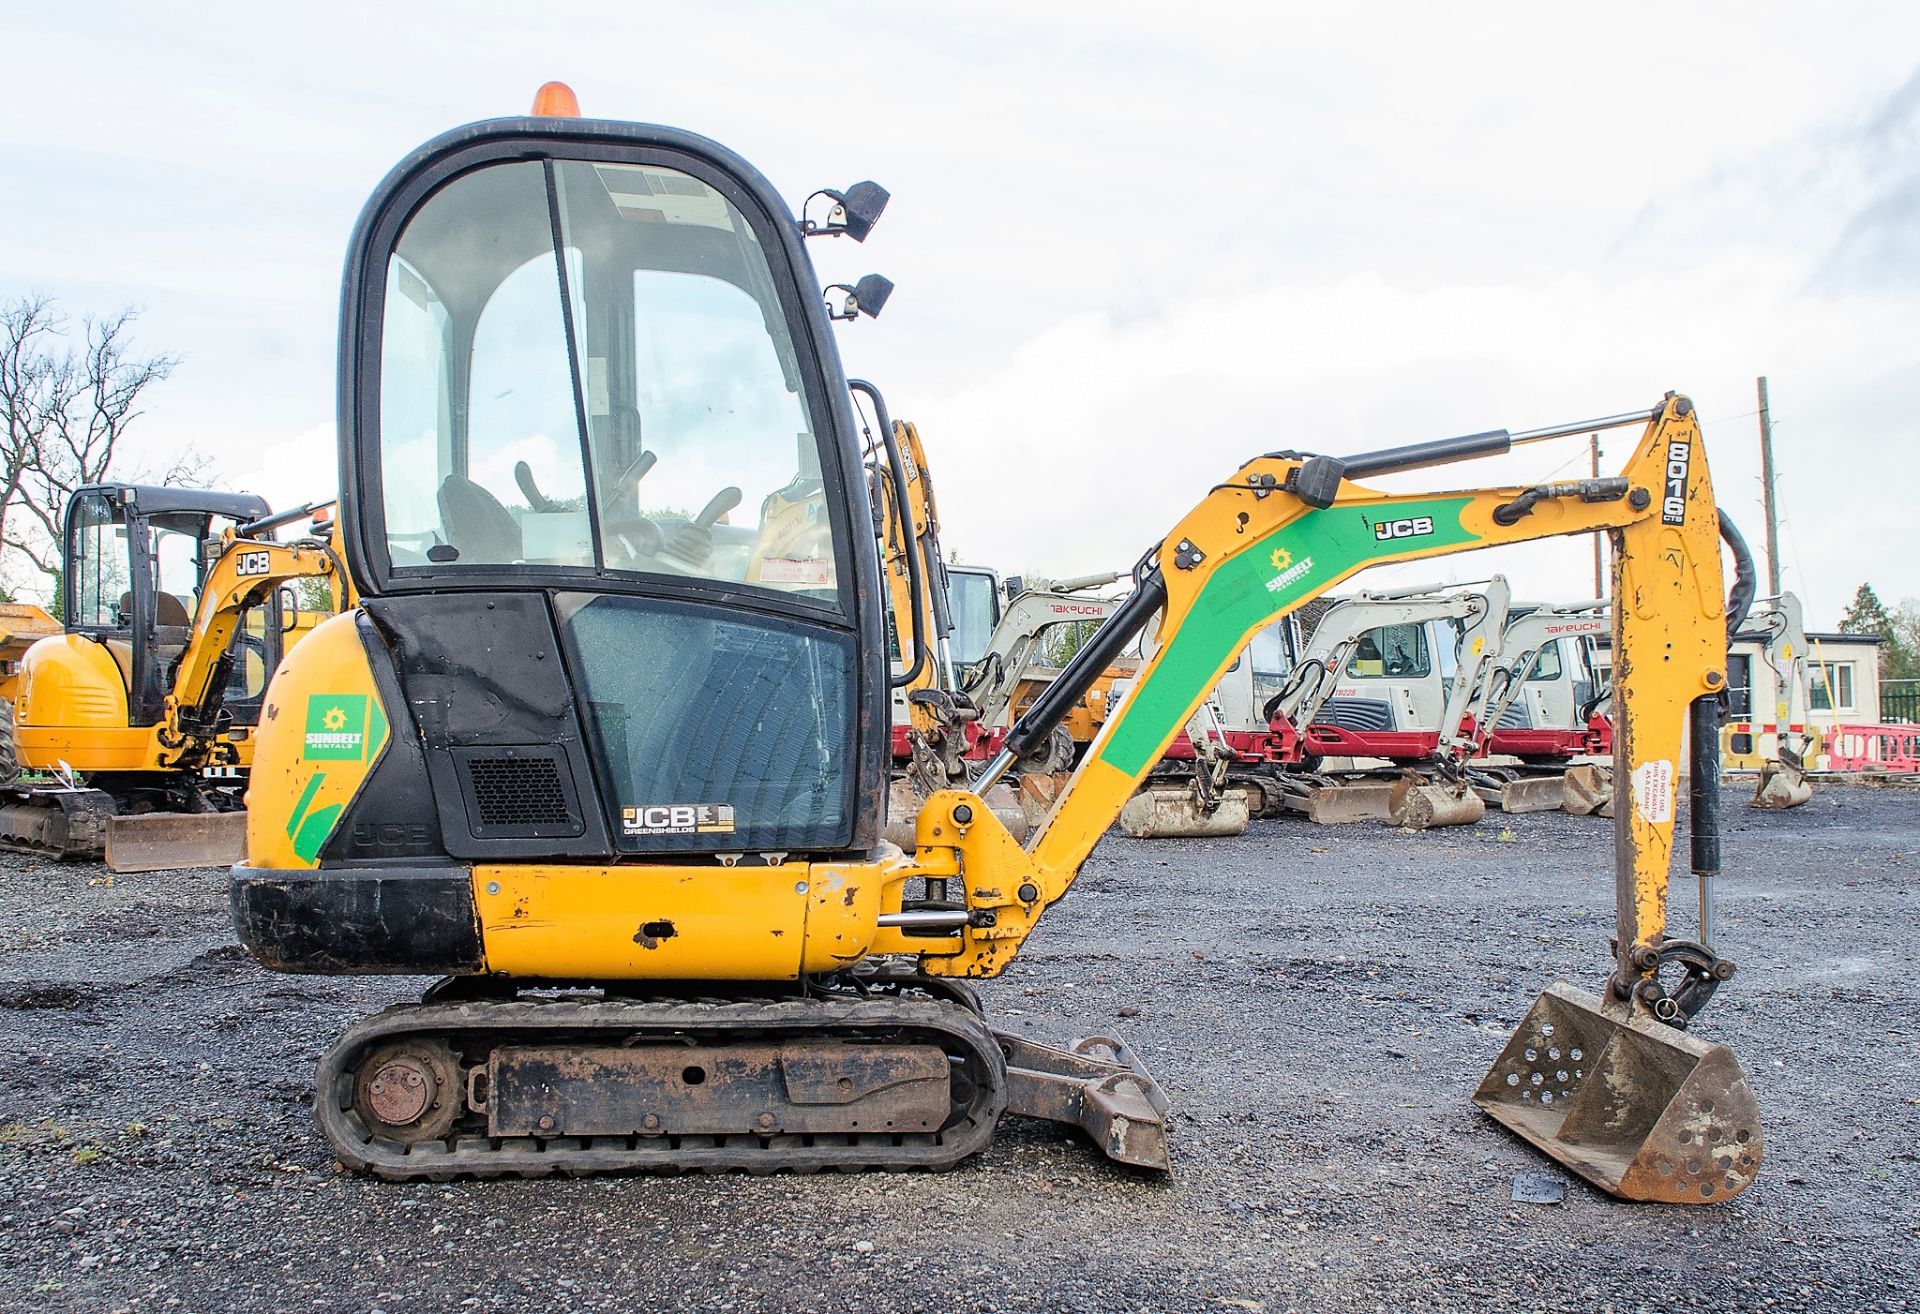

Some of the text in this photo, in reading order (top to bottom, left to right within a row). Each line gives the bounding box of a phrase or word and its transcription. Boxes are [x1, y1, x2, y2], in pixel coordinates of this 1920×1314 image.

[1663, 442, 1689, 516] 8016
[1375, 517, 1434, 540] JCB
[236, 552, 270, 575] JCB
[1265, 556, 1314, 592] SUNBELT
[305, 732, 363, 744] SUNBELT
[1651, 779, 1659, 820] EXCAVATOR
[623, 807, 696, 828] JCB
[354, 822, 434, 847] JCB
[623, 827, 696, 835] GREENSHIELDS
